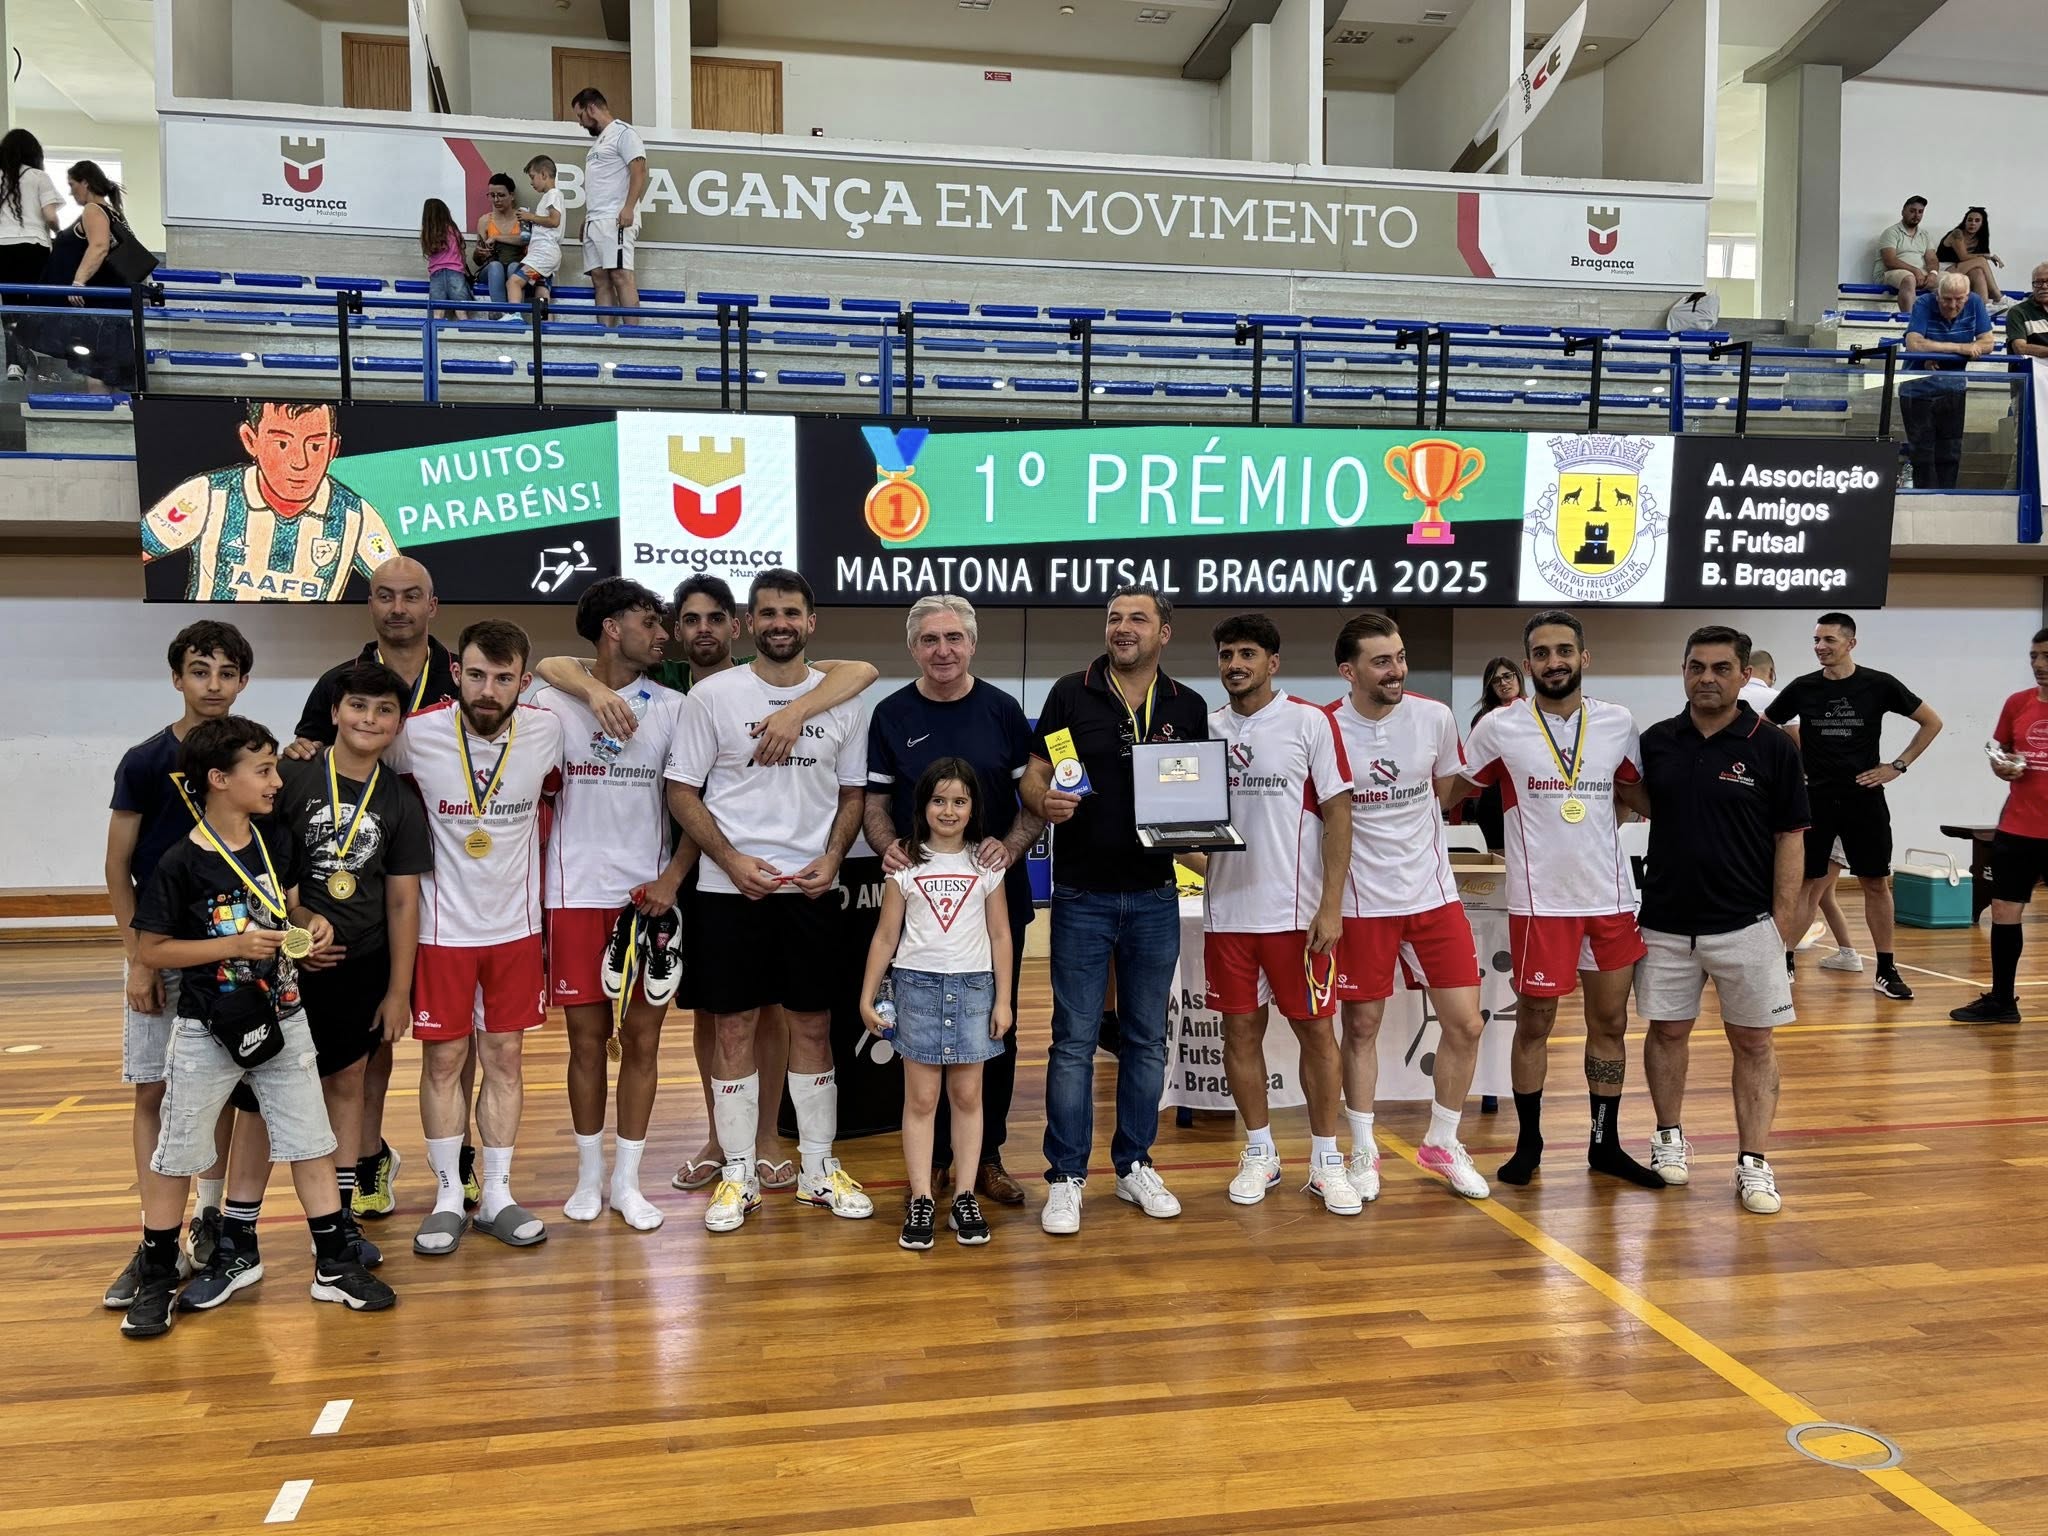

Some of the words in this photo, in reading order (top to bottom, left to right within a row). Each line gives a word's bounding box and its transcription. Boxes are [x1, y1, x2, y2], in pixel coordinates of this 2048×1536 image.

[262, 193, 348, 212] Bragança
[556, 163, 922, 239] BAGANÇA
[935, 183, 1028, 231] EM
[1046, 188, 1418, 249] MOVIMENTO
[1571, 256, 1635, 271] Bragança
[419, 440, 566, 487] MUITOS
[1707, 462, 1734, 487] A.
[1740, 463, 1880, 493] Associação
[1087, 435, 1369, 527] PRÉMIO
[398, 481, 603, 535] PARABÉNS!
[1704, 496, 1731, 520] A.
[1738, 496, 1830, 525] Amigos
[1703, 529, 1724, 553] F.
[1732, 530, 1805, 554] Futsal
[634, 542, 783, 572] Bragança
[235, 571, 322, 597] AAFB
[836, 555, 1033, 592] MARATONA
[1050, 558, 1180, 593] FUTSAL
[1199, 559, 1378, 602] BRAGANÇA
[1392, 560, 1489, 593] 2025
[1548, 574, 1573, 595] SANTA
[1577, 588, 1603, 599] MARIA
[1606, 588, 1612, 597] E
[1614, 562, 1648, 594] MEIXEDO
[1570, 575, 1584, 587] DAS
[1587, 568, 1629, 588] FREGUESIAS
[1627, 559, 1639, 571] DE
[1701, 562, 1727, 586] B.
[1735, 563, 1847, 590] Bragança
[566, 760, 607, 776] Benites
[608, 763, 657, 779] Torneiro
[1242, 772, 1288, 788] Torneiro
[1351, 789, 1389, 803] enites
[1390, 780, 1429, 801] Torneiro
[438, 799, 487, 816] Benits
[489, 798, 533, 816] Torneiro
[923, 880, 967, 892] GUESS
[243, 1023, 267, 1048] NIKE
